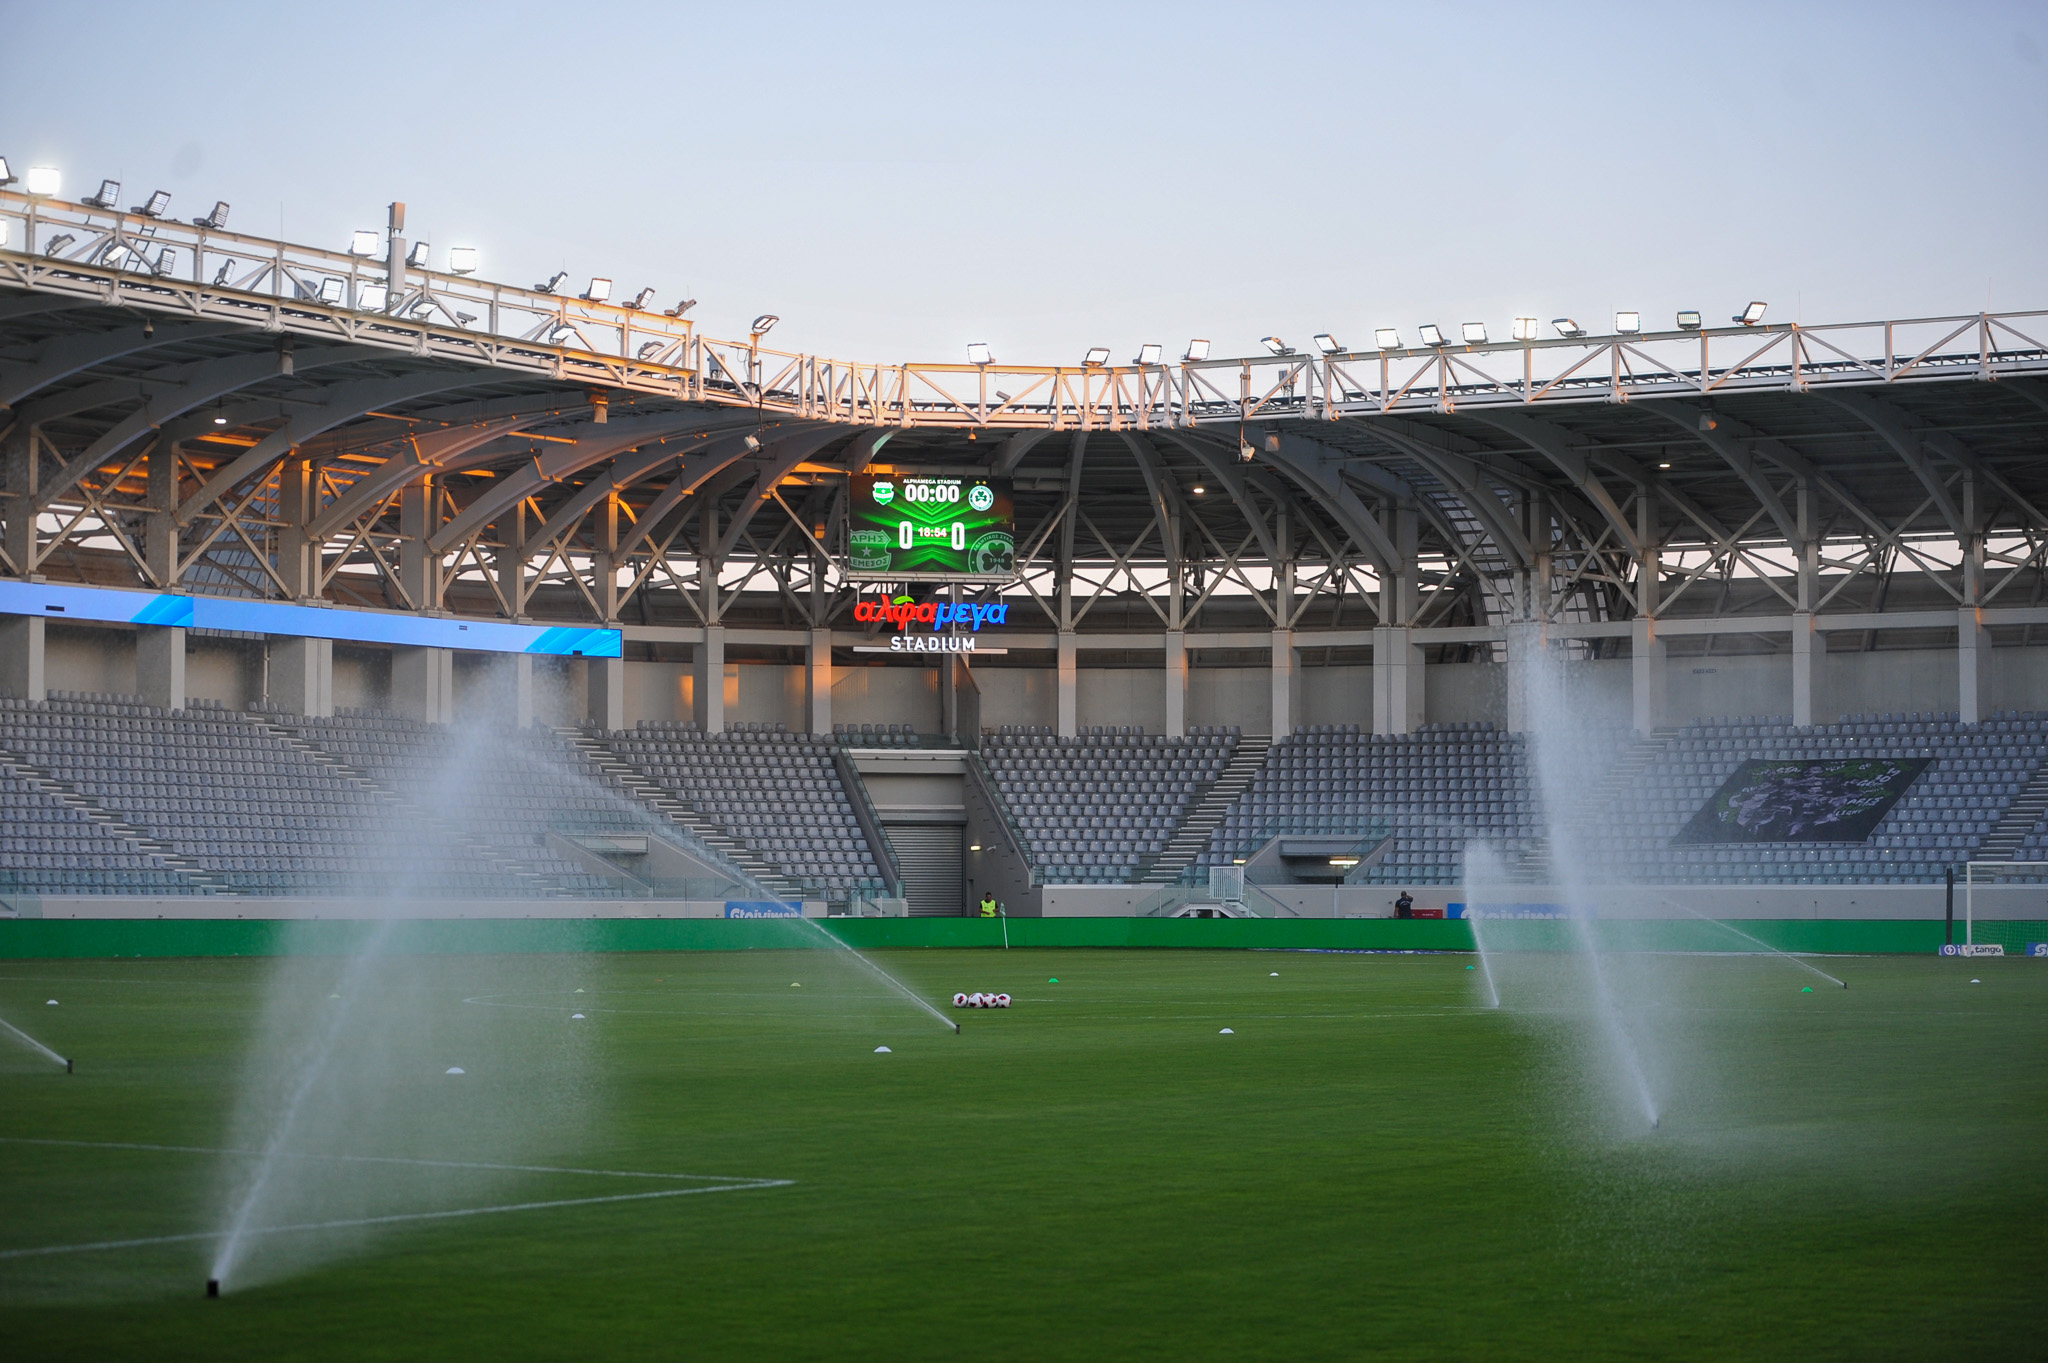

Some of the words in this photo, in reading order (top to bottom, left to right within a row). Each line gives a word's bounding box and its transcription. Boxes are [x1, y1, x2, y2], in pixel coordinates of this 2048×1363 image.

[905, 484, 960, 503] 00:00
[851, 535, 885, 543] ΑΡΗΣ
[899, 521, 913, 549] 0
[918, 527, 948, 538] 18:54
[951, 522, 965, 550] 0
[890, 636, 976, 652] STADIUM
[1974, 946, 2002, 954] tango
